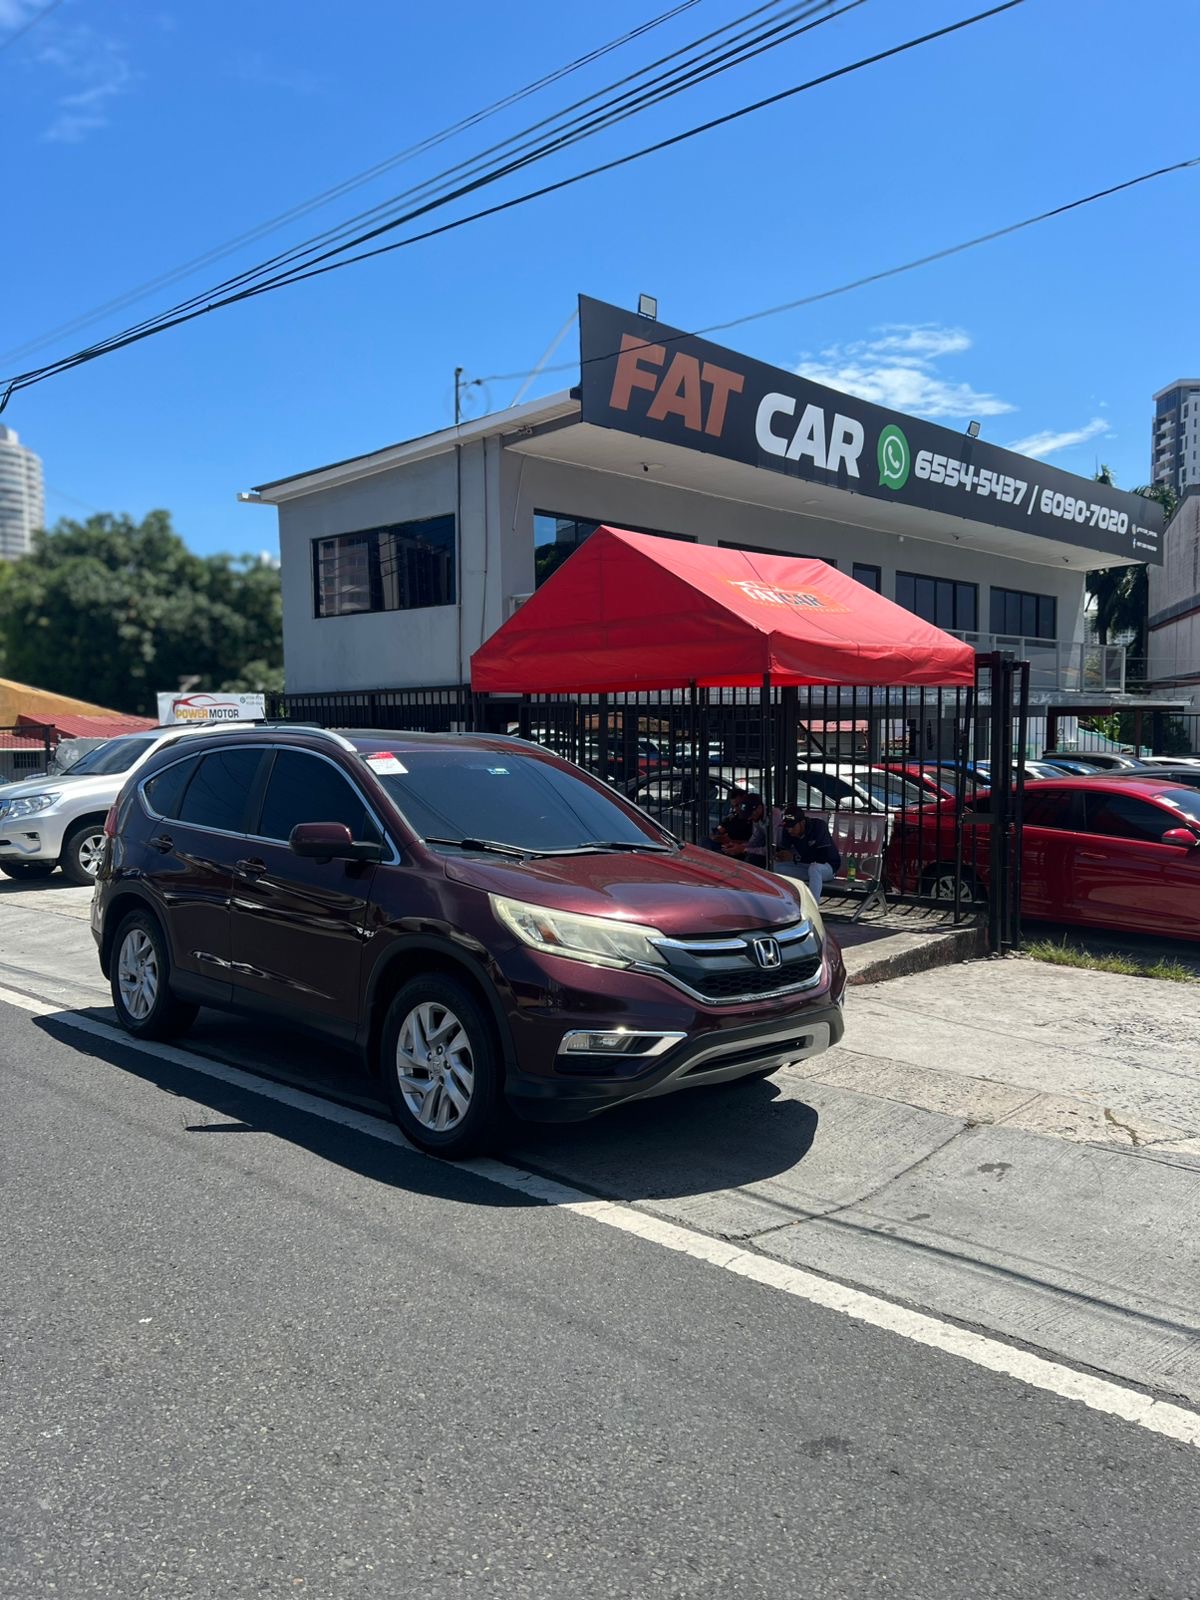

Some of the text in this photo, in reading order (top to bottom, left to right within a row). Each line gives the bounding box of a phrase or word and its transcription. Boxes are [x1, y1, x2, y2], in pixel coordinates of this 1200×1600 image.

[609, 333, 745, 437] FAT
[755, 392, 864, 478] CAR
[914, 450, 1028, 505] 6554-5437
[1040, 488, 1129, 535] 6090-7020
[175, 708, 239, 719] POWER MOTOR
